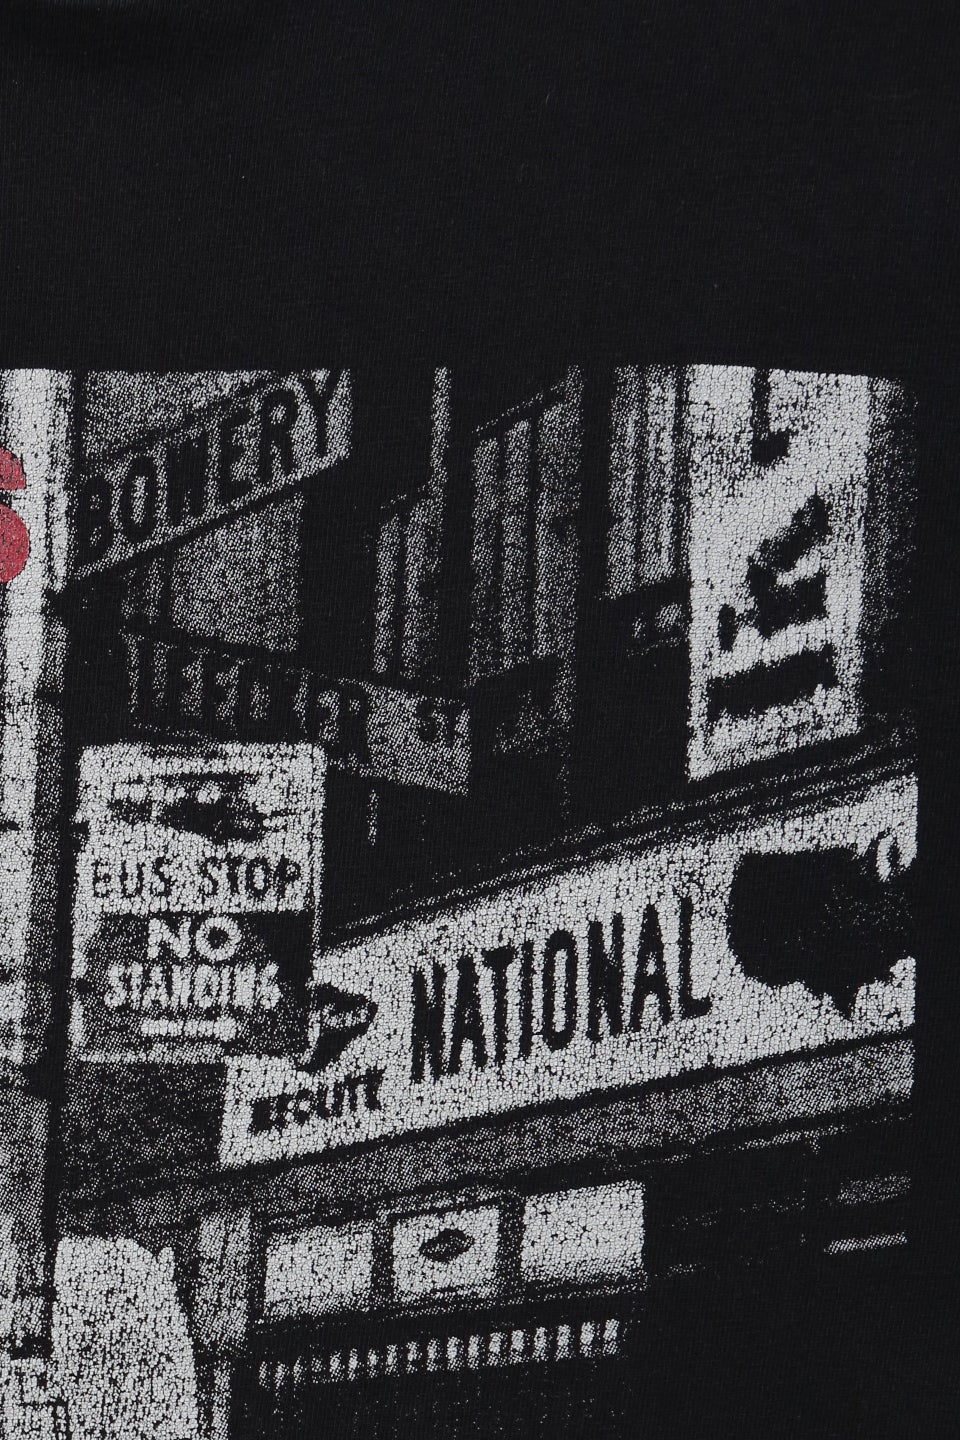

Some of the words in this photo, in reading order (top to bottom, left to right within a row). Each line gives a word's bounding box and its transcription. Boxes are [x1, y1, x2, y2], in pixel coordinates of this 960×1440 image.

[76, 367, 342, 563] BOWERY
[198, 854, 303, 899] STOP
[146, 915, 242, 961] NO
[104, 961, 282, 1010] STANDING
[410, 892, 714, 1083] NATIONAL
